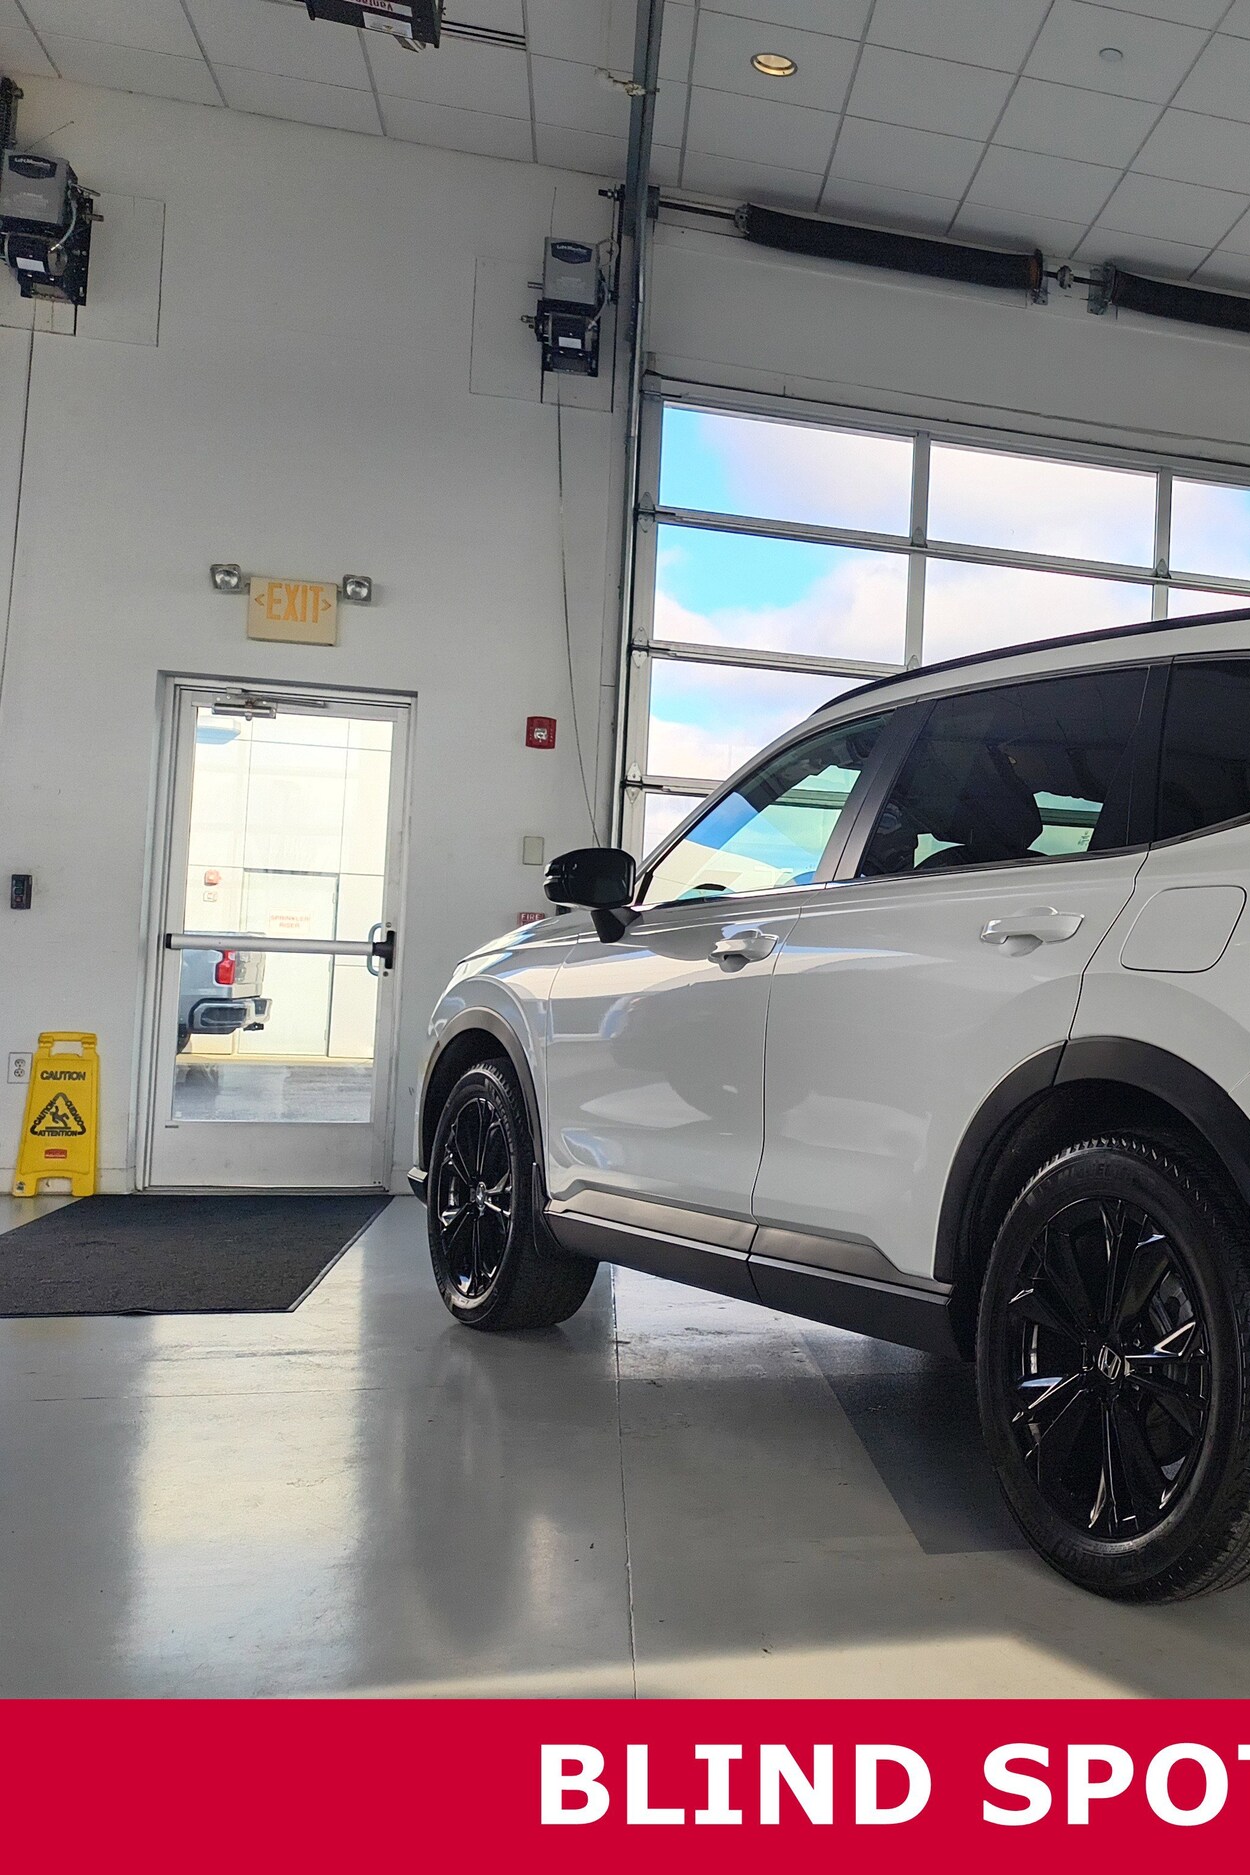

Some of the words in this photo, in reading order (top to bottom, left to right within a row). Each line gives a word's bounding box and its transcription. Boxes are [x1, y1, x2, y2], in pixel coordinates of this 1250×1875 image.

[266, 582, 324, 624] EXIT
[521, 913, 540, 921] FIRE
[40, 1070, 86, 1081] CAUTION
[33, 1099, 56, 1126] CAUTION
